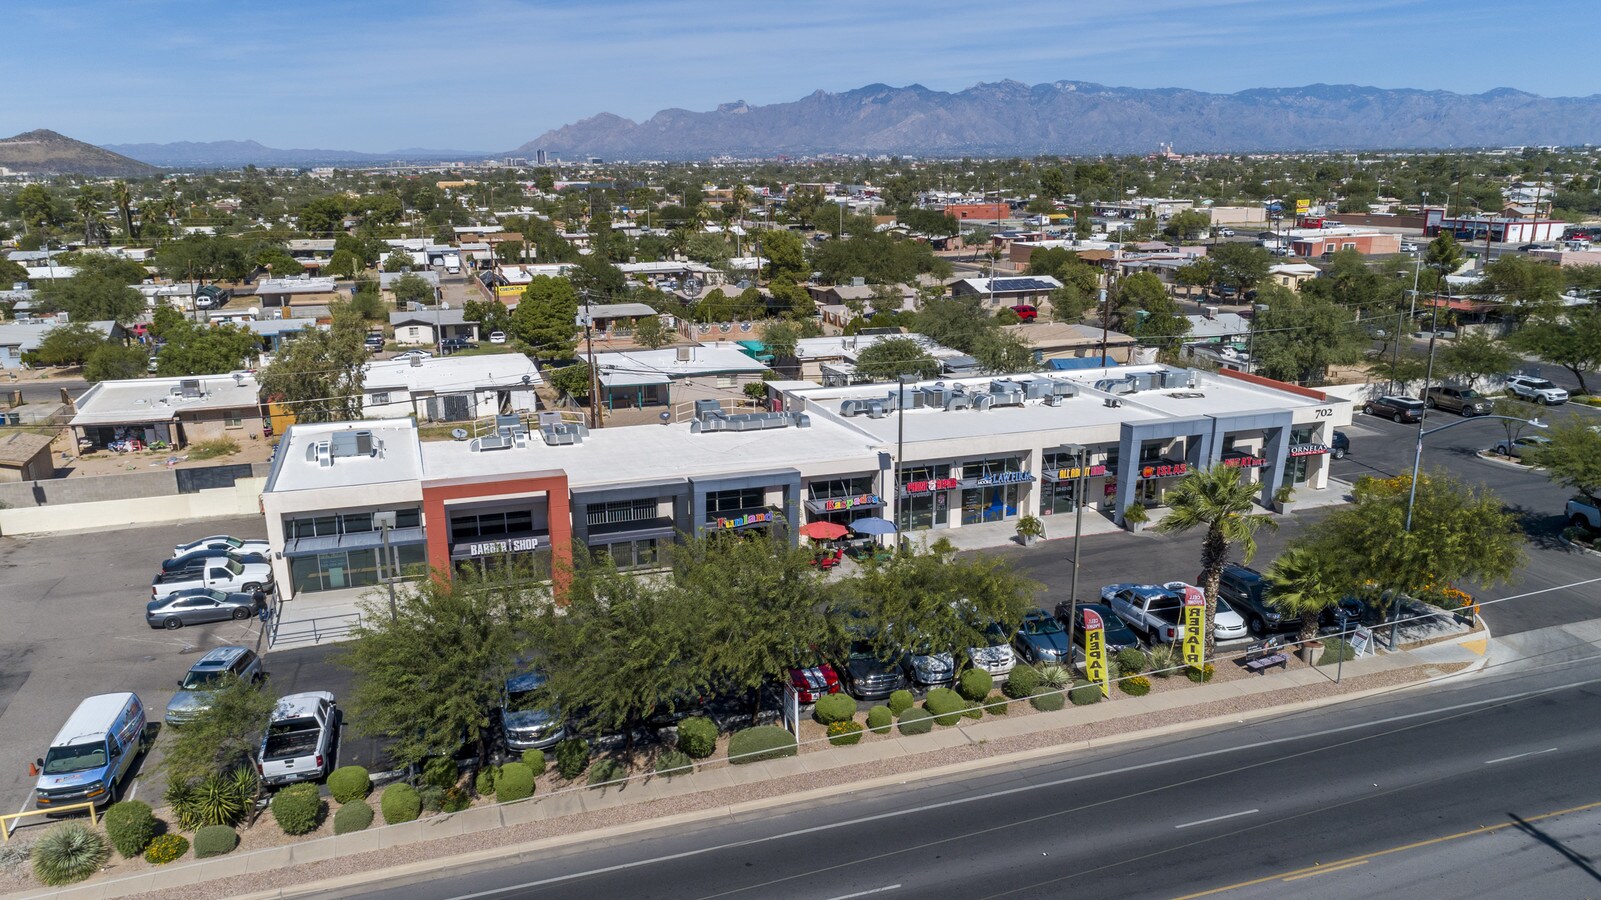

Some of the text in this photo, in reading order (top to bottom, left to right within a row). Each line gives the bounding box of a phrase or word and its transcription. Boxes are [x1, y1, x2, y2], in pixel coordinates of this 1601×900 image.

[1315, 408, 1333, 419] 702
[993, 470, 1033, 484] LAW FIRM
[1156, 463, 1187, 477] ISLAS
[826, 494, 879, 510] Raspados
[717, 511, 773, 529] Funland
[513, 538, 539, 551] SHOP
